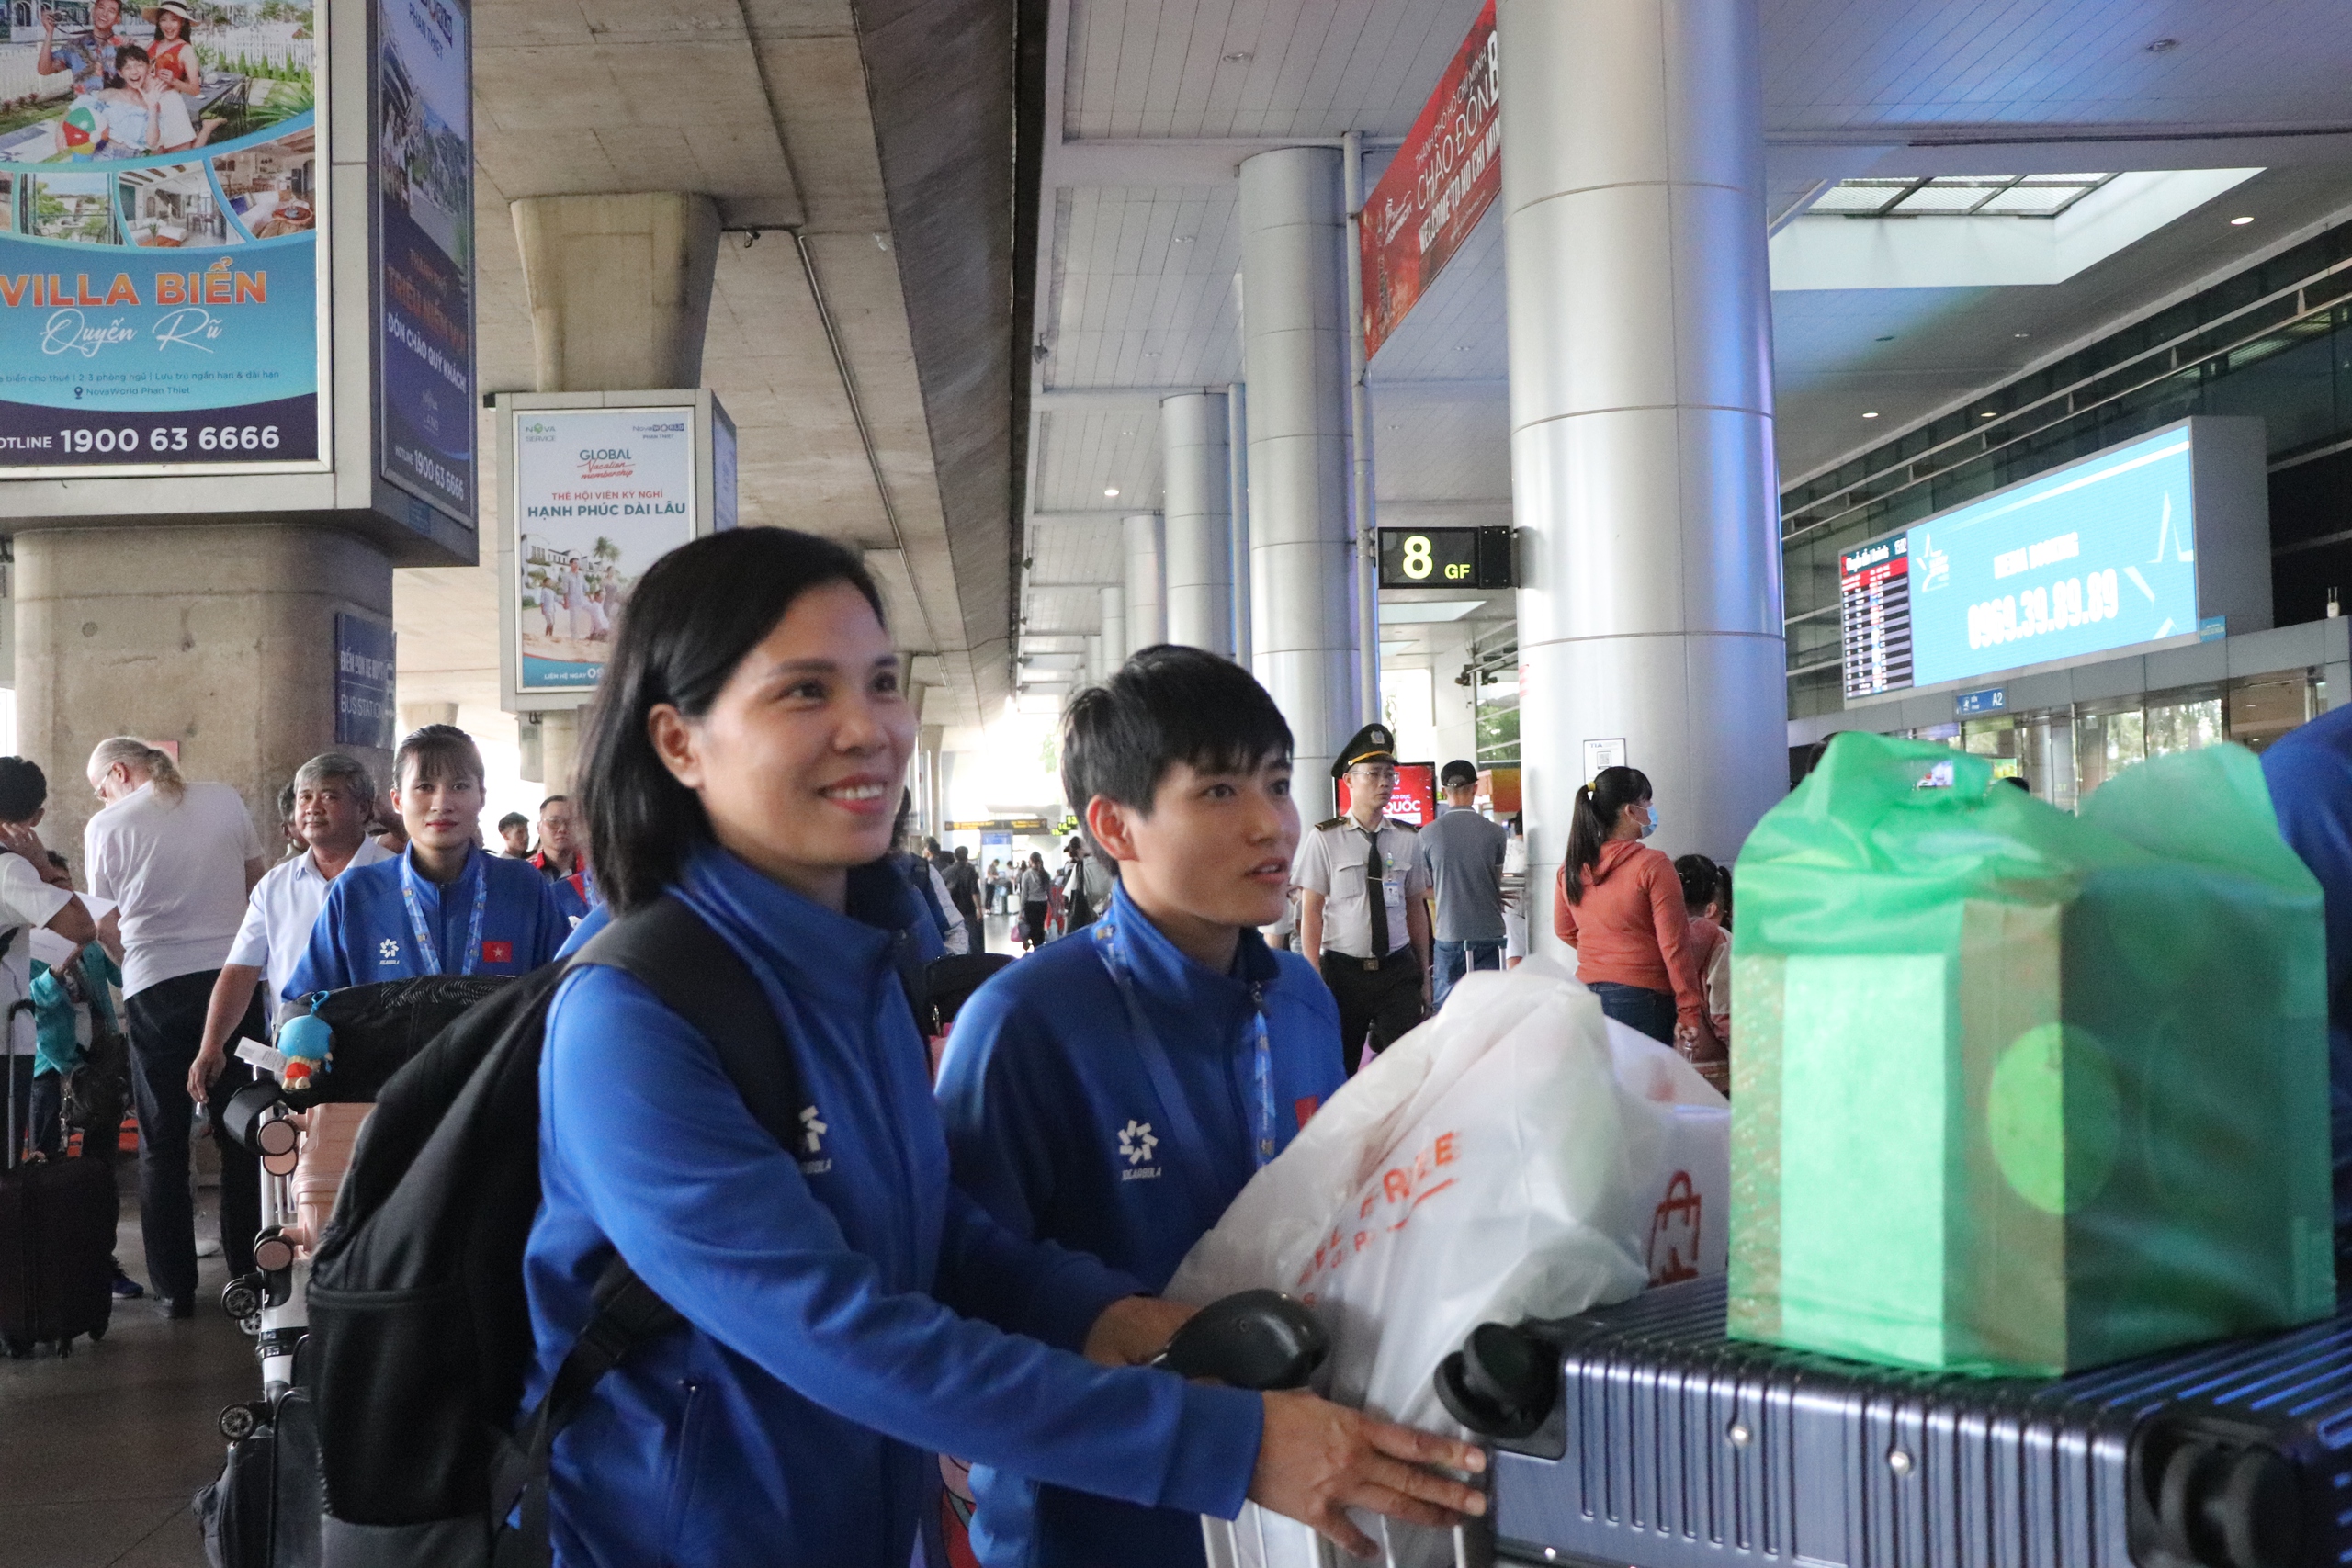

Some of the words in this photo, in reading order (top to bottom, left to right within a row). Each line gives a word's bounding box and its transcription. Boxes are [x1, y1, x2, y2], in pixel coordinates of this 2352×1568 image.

[1468, 46, 1487, 83] MINH
[1418, 133, 1453, 210] CHÀO
[1456, 73, 1489, 156] ĐÓN
[1488, 30, 1499, 107] B
[1419, 188, 1451, 254] WELCOME
[1451, 175, 1461, 211] TO
[1461, 159, 1471, 199] HO
[1472, 139, 1486, 183] CHI
[1486, 114, 1501, 164] MIN
[0, 273, 141, 307] VILLA
[155, 256, 266, 305] BIỂN
[40, 308, 138, 357] Quyến
[152, 308, 223, 354] Rũ
[388, 312, 406, 344] ĐÓN
[406, 328, 428, 360] CHÀO
[428, 345, 443, 373] QUÝ
[28, 372, 48, 382] cho
[79, 373, 94, 381] 2-3
[96, 373, 127, 383] phòng
[236, 371, 243, 379] &
[245, 369, 260, 378] dài
[262, 369, 279, 379] hạn
[141, 387, 164, 395] Phan
[0, 436, 52, 449] OTLINE
[60, 428, 140, 453] 1900
[150, 427, 188, 451] 63
[198, 425, 280, 450] 6666
[526, 434, 557, 443] SERVICE
[579, 448, 633, 460] GLOBAL
[414, 448, 434, 482] 1900
[435, 464, 445, 490] 63
[446, 470, 465, 502] 6666
[580, 469, 635, 479] membership
[574, 490, 593, 502] HỘI
[527, 505, 573, 521] HẠNH
[577, 502, 619, 516] PHÚC
[624, 501, 650, 515] DÀI
[655, 500, 686, 514] LÂU
[1402, 535, 1433, 580] 8
[1444, 563, 1471, 580] GF
[340, 694, 357, 715] BUS
[1992, 691, 2004, 707] A2
